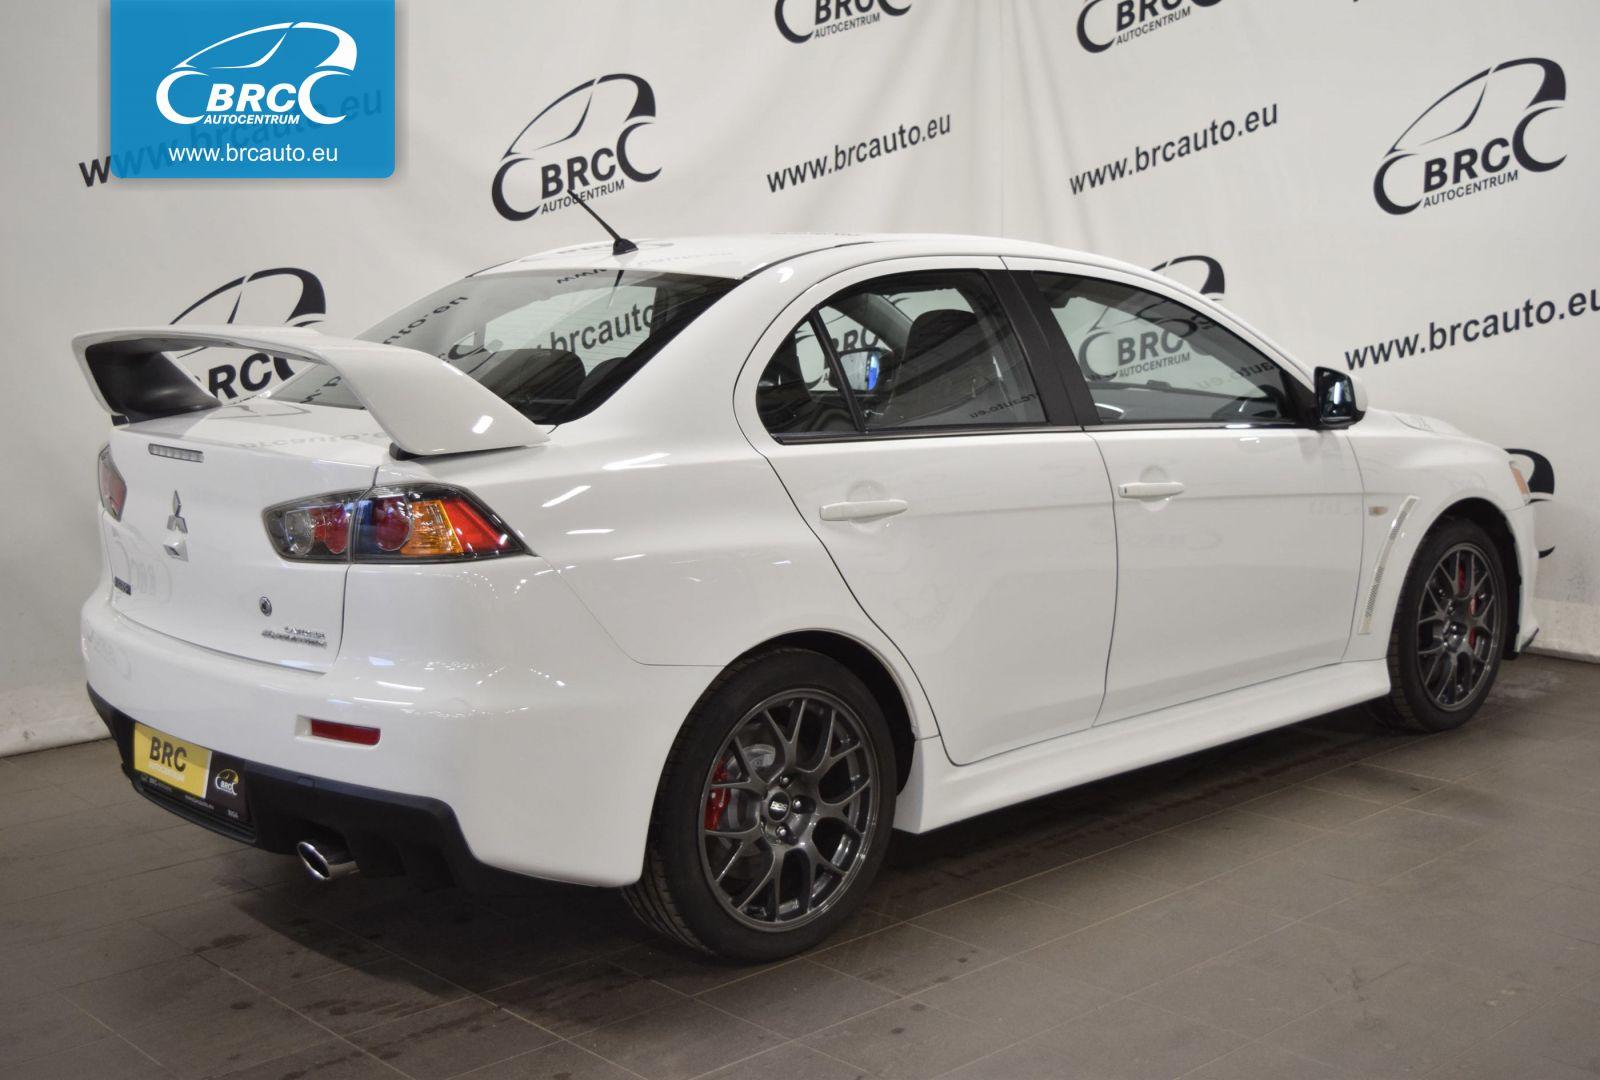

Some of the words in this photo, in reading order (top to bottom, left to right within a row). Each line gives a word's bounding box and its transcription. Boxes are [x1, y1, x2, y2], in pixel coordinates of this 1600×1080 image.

[814, 12, 880, 39] AUTOCENTRUM
[1116, 6, 1191, 45] AUTOCENTRUM
[767, 114, 951, 193] www.brcauto.eu
[1069, 103, 1277, 195] www.brcauto.eu
[1423, 137, 1510, 193] BRC
[541, 147, 616, 199] BRC
[1423, 169, 1519, 209] AUTOCENTRUM
[541, 179, 625, 215] AUTOCENTRUM
[208, 352, 273, 400] RC
[1118, 352, 1191, 378] AUTOCENTRUM
[149, 735, 188, 773] BRC
